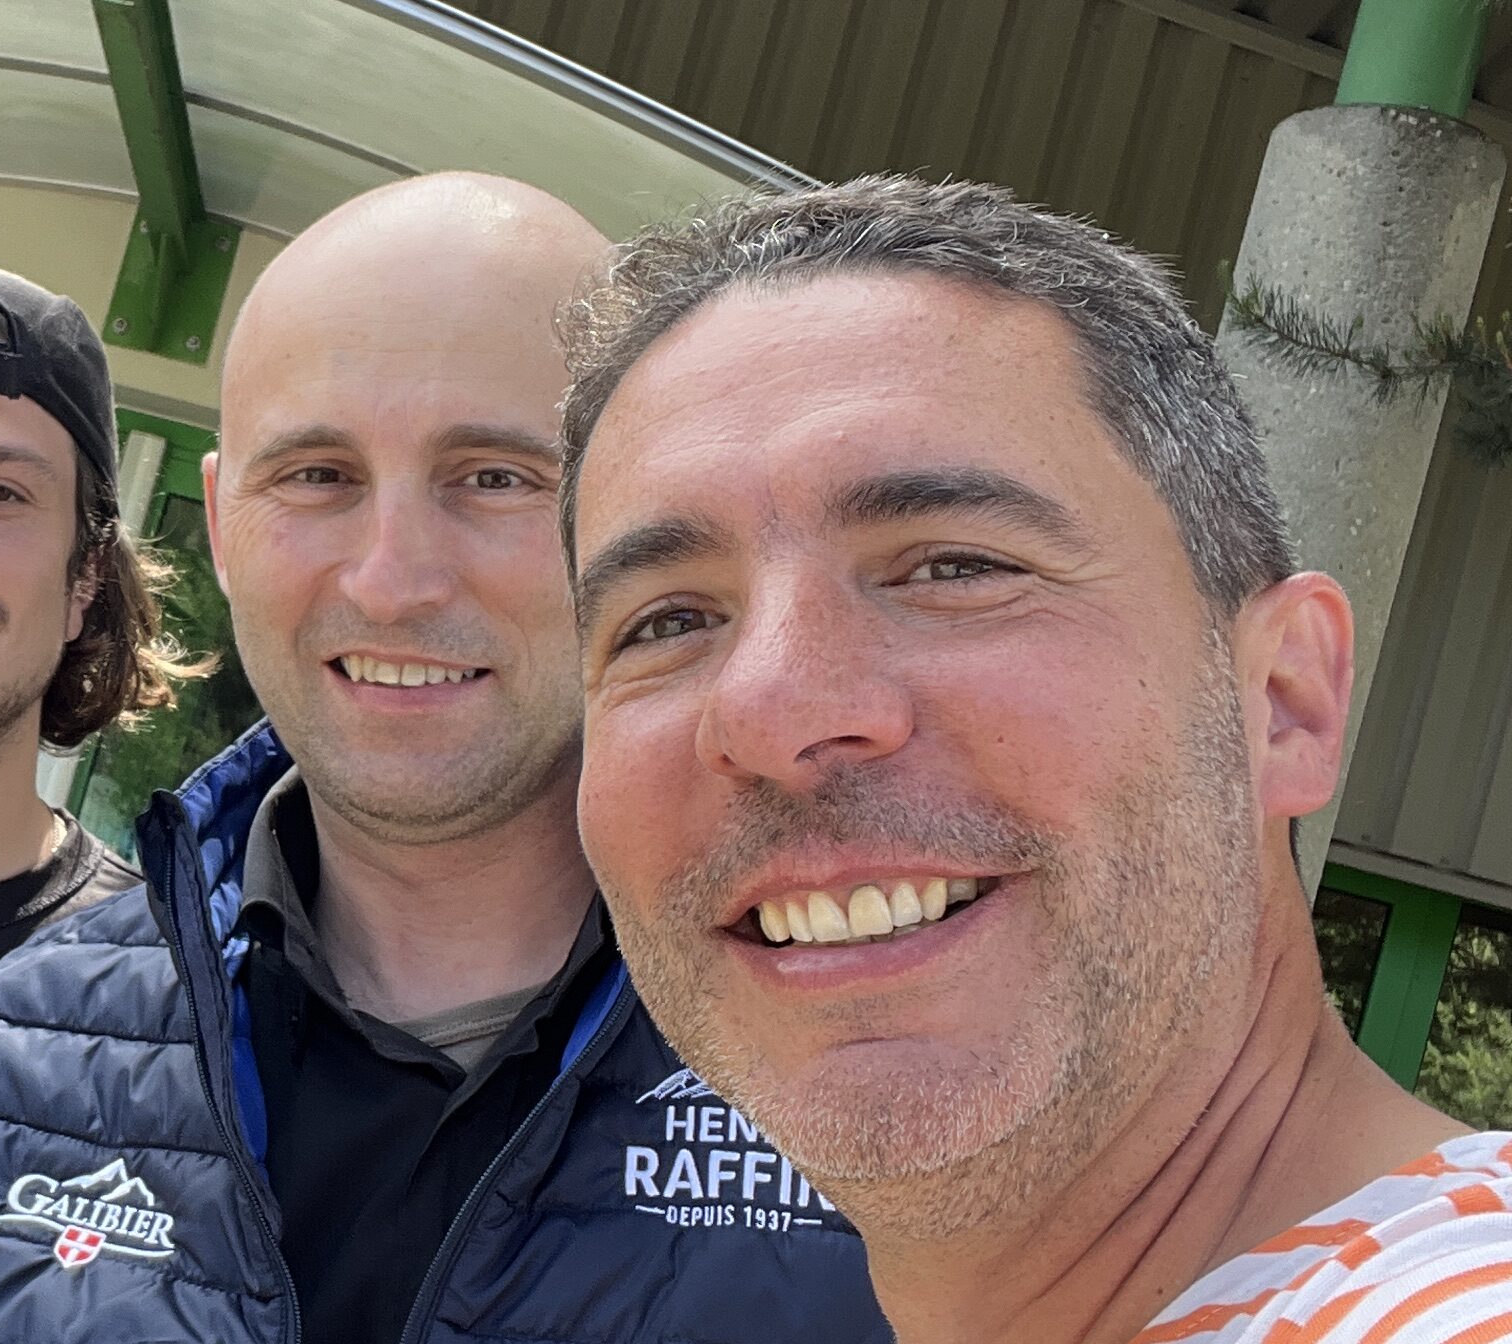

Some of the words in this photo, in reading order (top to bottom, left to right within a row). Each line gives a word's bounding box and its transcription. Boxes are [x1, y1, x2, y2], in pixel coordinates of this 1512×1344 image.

[664, 1104, 774, 1144] HEN
[7, 1173, 176, 1249] GALIBIER
[665, 1204, 735, 1227] DEPUIS
[743, 1205, 792, 1232] 1937
